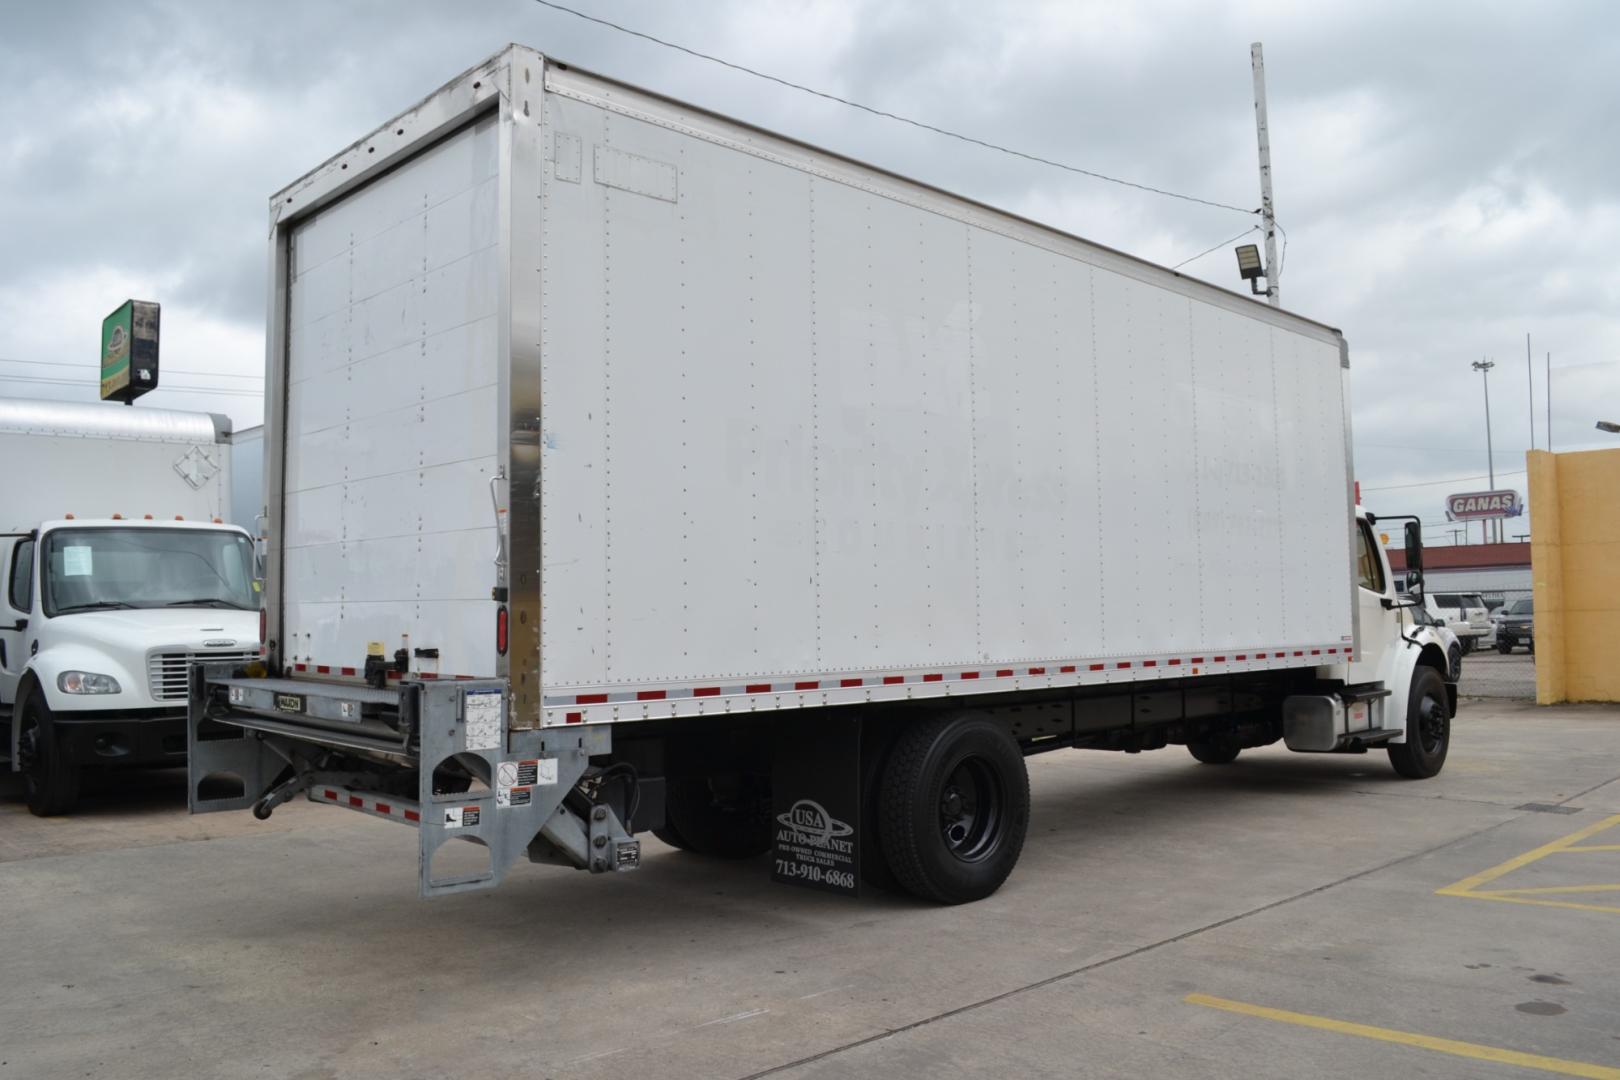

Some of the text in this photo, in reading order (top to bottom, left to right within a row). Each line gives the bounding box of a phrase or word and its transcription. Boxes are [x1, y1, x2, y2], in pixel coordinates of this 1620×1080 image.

[1453, 495, 1512, 513] GANAS
[795, 809, 824, 828] USA
[776, 829, 807, 845] AUTO
[775, 859, 854, 889] 713-910-6868
